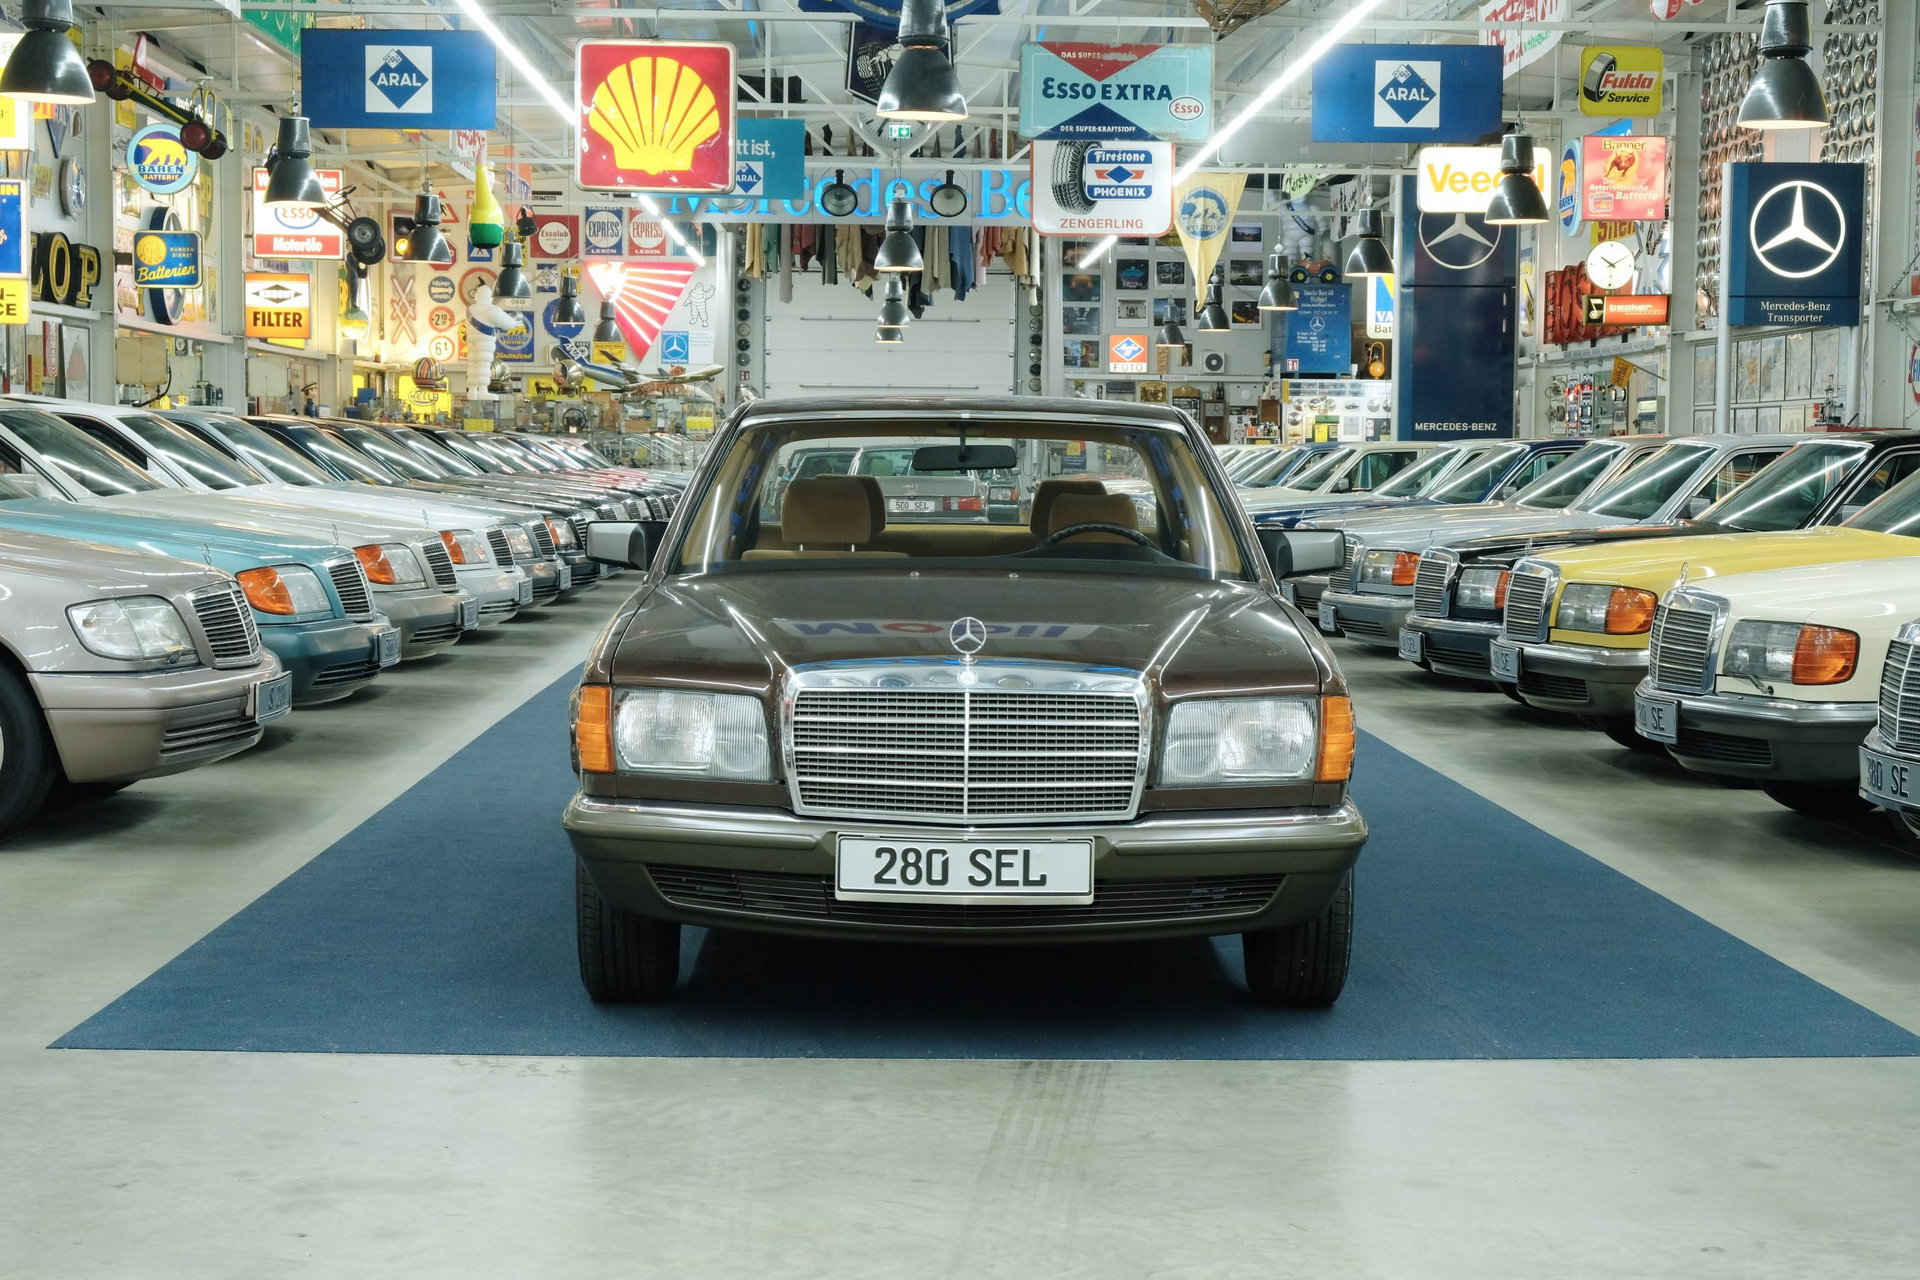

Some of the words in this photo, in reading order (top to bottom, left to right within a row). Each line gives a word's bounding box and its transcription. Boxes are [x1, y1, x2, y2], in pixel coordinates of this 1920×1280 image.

[376, 72, 422, 87] ARAL
[1602, 73, 1654, 89] Fulda
[1101, 84, 1173, 101] EXTRA
[1386, 87, 1430, 101] ARAL
[1607, 92, 1650, 103] Service
[1075, 125, 1137, 133] SUPER-KRAFTSTOFF
[751, 139, 776, 159] ist,
[1603, 139, 1646, 151] Banner
[1094, 151, 1146, 162] Firestone
[736, 174, 759, 182] ARAL
[1426, 163, 1545, 193] Veel
[1094, 187, 1146, 197] PHOENIX
[1615, 191, 1658, 200] Batterie
[588, 221, 620, 238] EXPRESS
[632, 221, 664, 238] EXPRESS
[1060, 218, 1144, 229] ZENGERLING
[541, 229, 569, 237] Essolub
[137, 263, 196, 282] Batterien
[1609, 303, 1653, 312] becker
[1760, 301, 1831, 311] Mercedes-Benz
[252, 311, 303, 328] FILTER
[1768, 313, 1824, 324] Transporter
[1113, 363, 1143, 371] FOTO
[1415, 422, 1497, 431] MERCEDES-BENZ
[1651, 706, 1665, 732] SE
[1891, 764, 1910, 798] SE
[874, 847, 949, 886] 280
[968, 848, 1047, 887] SEL
